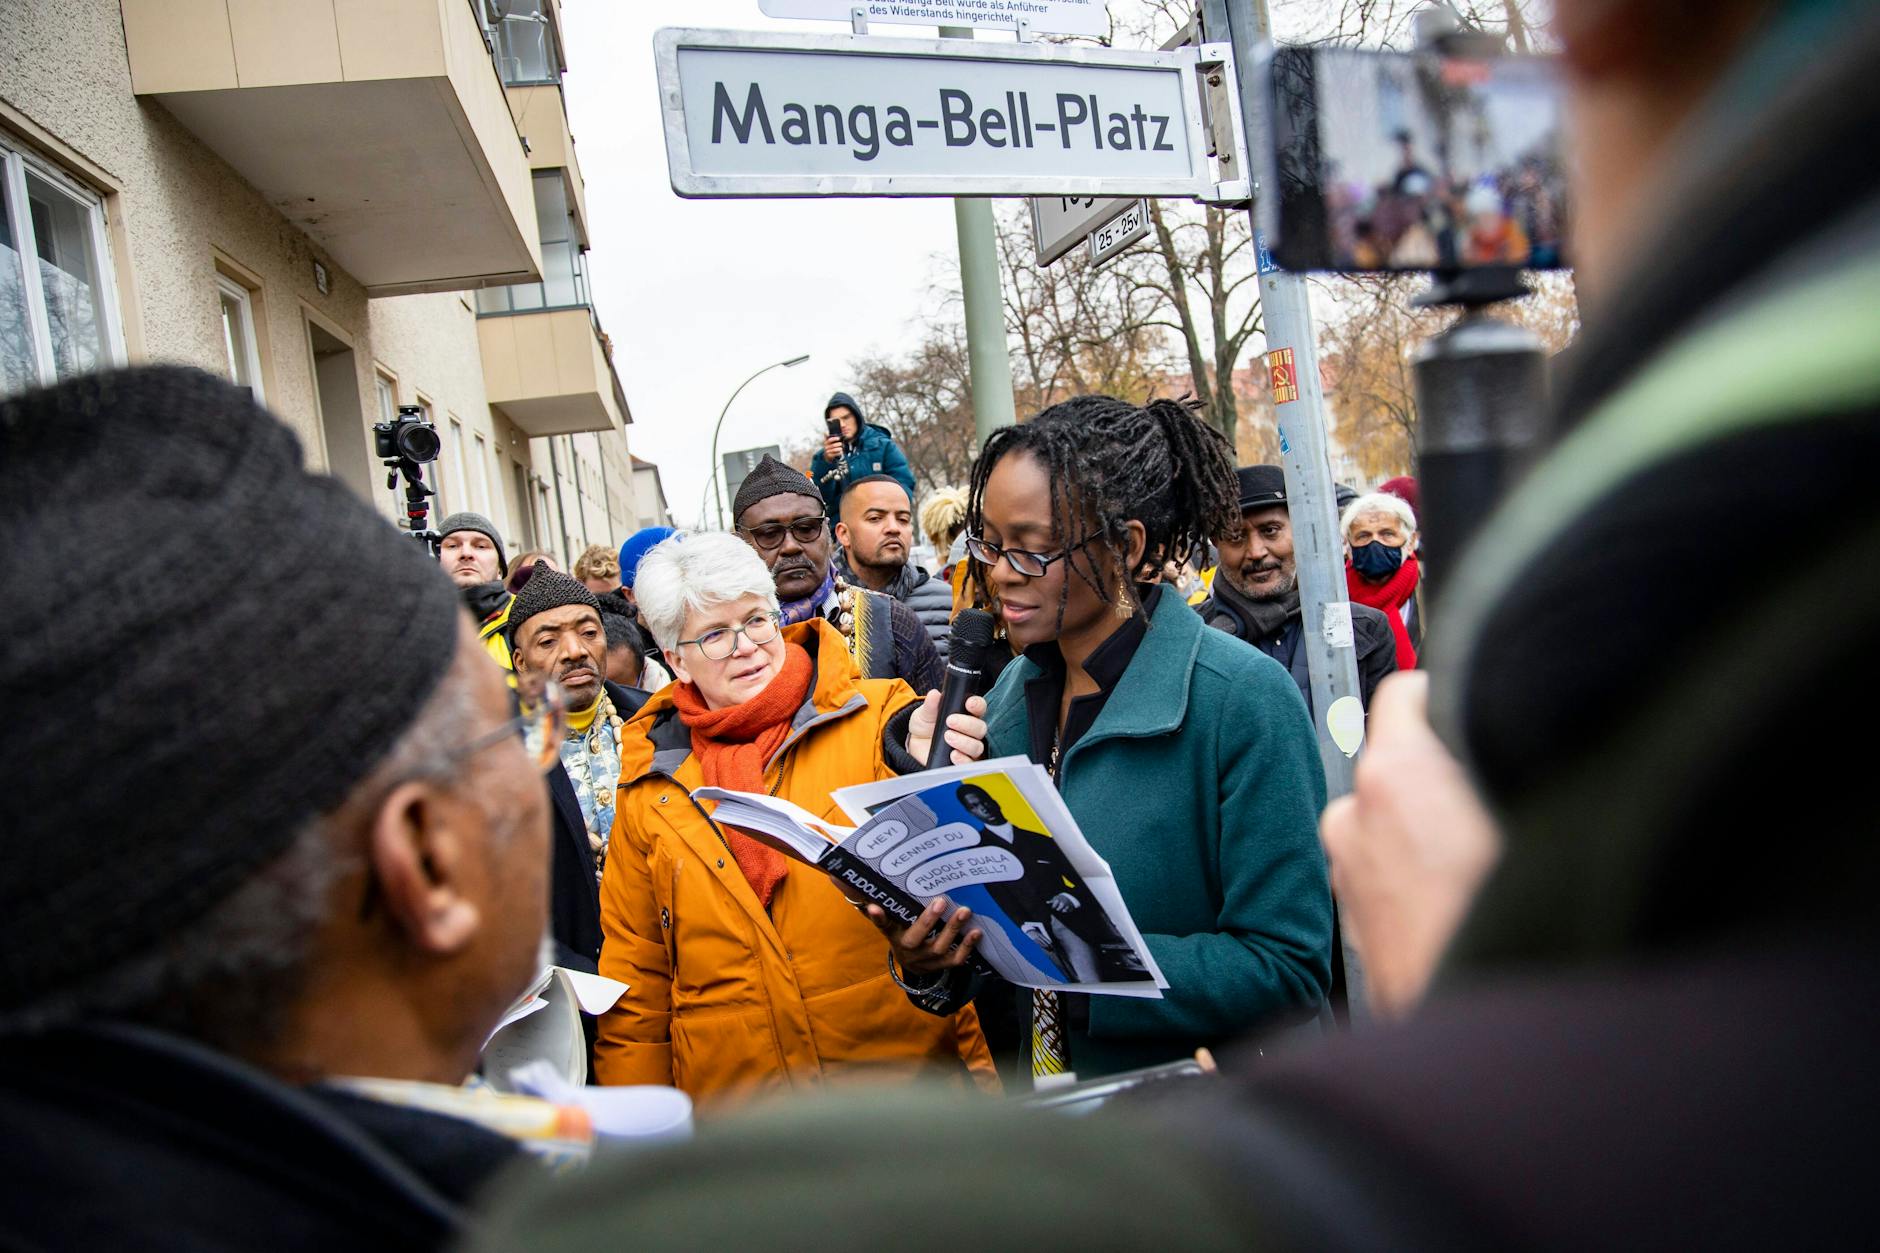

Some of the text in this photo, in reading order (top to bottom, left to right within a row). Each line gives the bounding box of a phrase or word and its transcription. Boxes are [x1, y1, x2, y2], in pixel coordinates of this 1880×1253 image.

[869, 5, 888, 15] des
[890, 5, 954, 19] Widerstands
[957, 0, 987, 8] wurde
[991, 0, 1004, 10] als
[1007, 1, 1048, 13] Anführer
[711, 81, 1175, 162] Manga-Bell-Platz
[1098, 229, 1113, 251] 25
[1121, 212, 1139, 236] 25v
[891, 831, 964, 868] KENNST DU
[915, 854, 1010, 886] RUDOLF DUALA
[923, 864, 1007, 892] MANGA BELL?
[841, 869, 918, 924] RUDOLF DUALA
